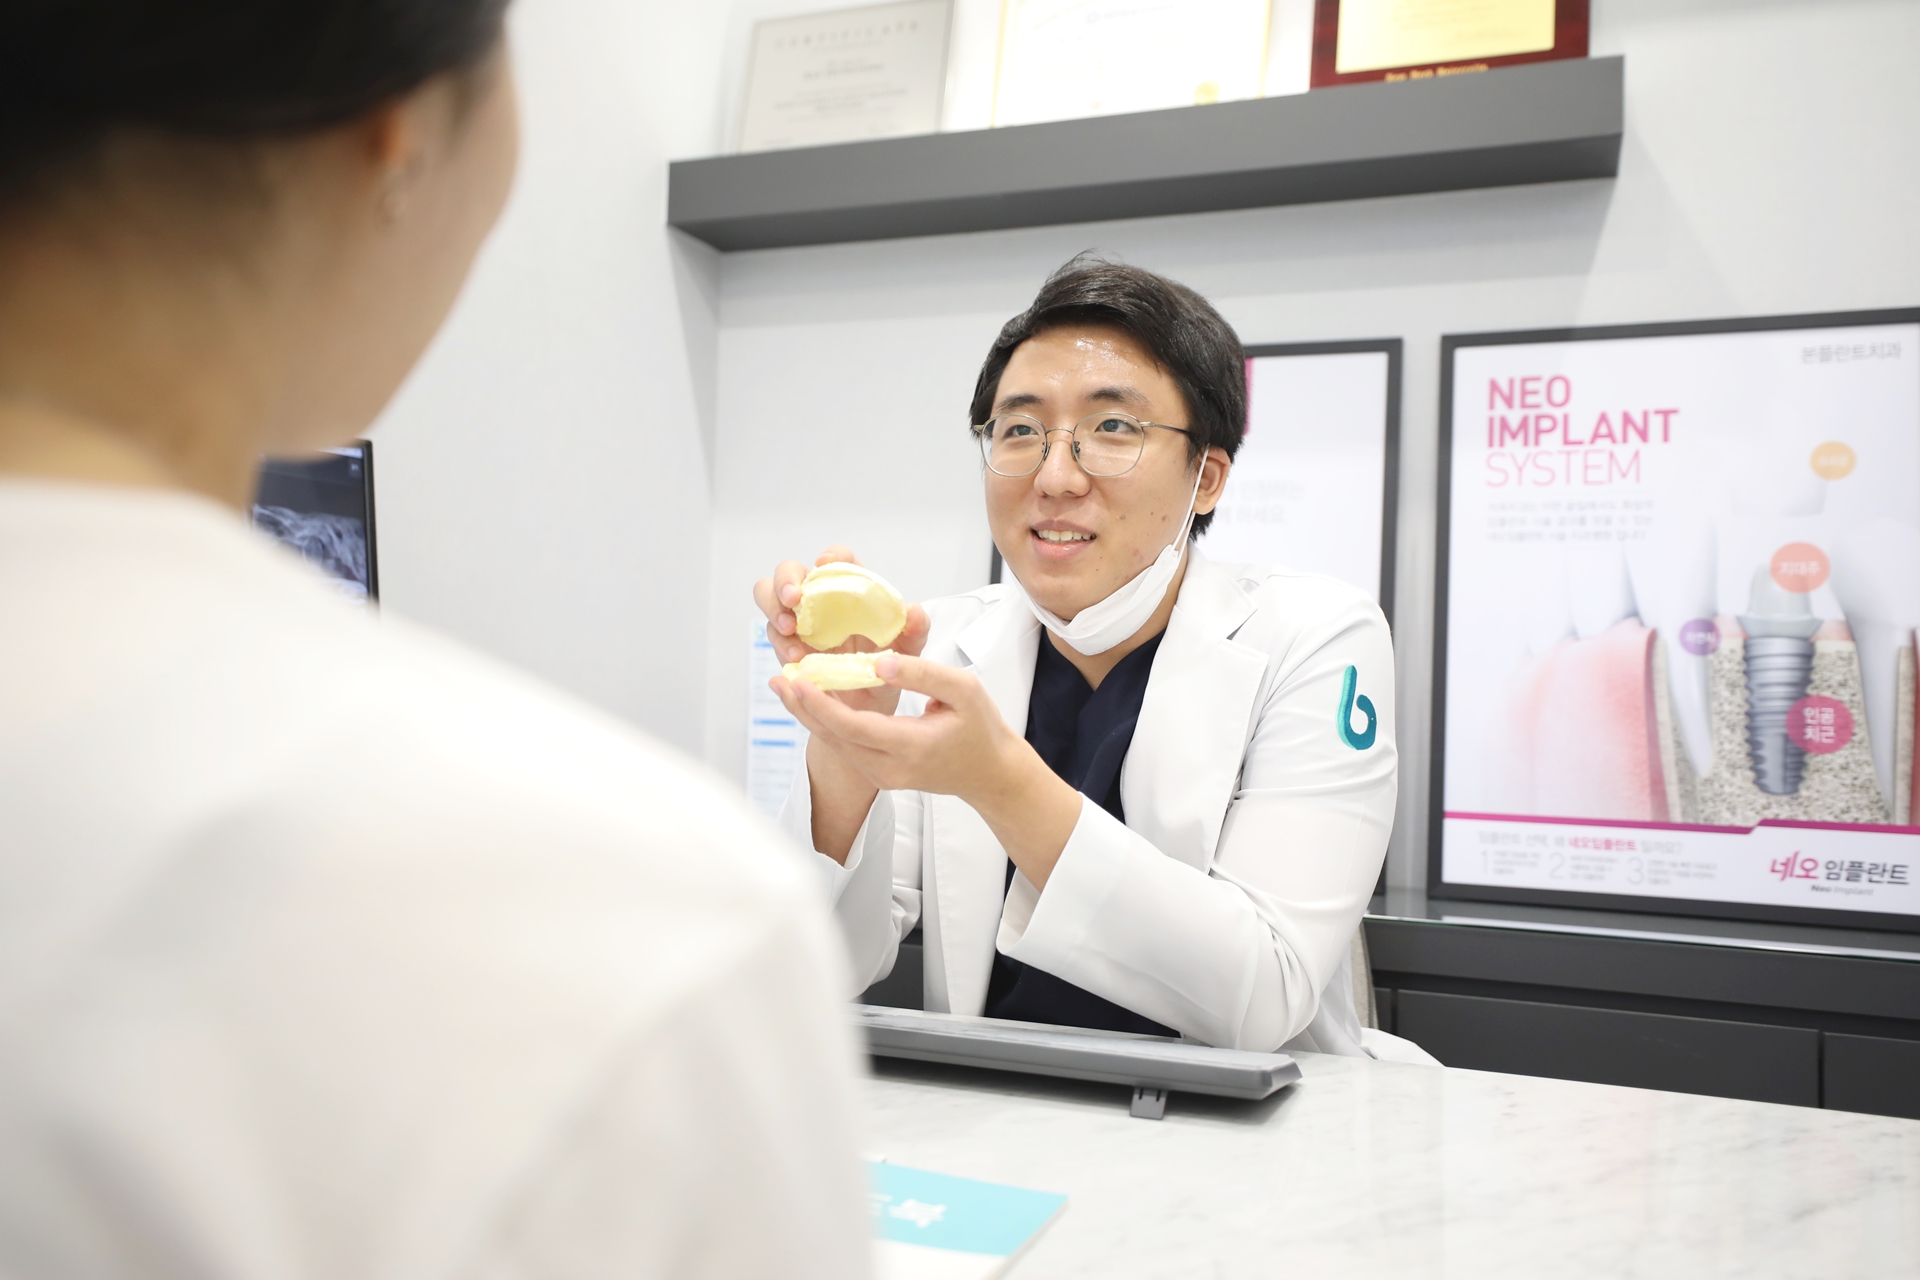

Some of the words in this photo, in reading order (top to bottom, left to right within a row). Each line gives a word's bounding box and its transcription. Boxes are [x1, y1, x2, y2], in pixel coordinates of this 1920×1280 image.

[1802, 341, 1901, 365] 본플란트치과
[1488, 375, 1572, 411] NEO
[1488, 408, 1679, 448] IMPLANT
[1486, 449, 1640, 487] SYSTEM
[1779, 560, 1822, 577] 지대주
[1803, 707, 1836, 726] 인공
[1803, 726, 1836, 744] 치근
[1568, 837, 1638, 852] 네오임플란트
[1549, 851, 1566, 879] 2
[1626, 856, 1645, 886] 3
[1770, 850, 1819, 882] 네오
[1825, 859, 1909, 885] 임플란트
[1810, 884, 1832, 893] Neo
[1833, 884, 1874, 896] Implant
